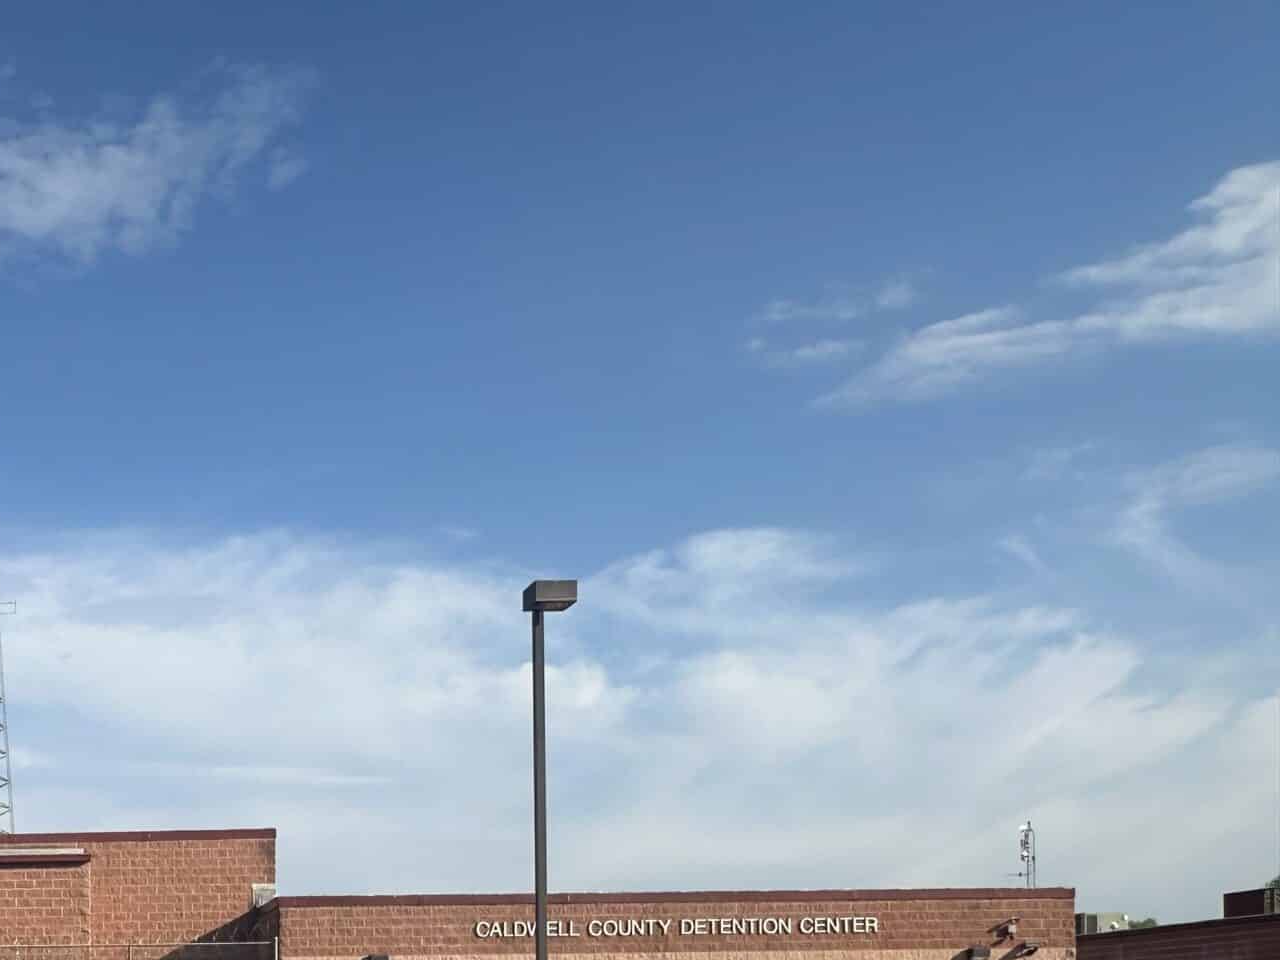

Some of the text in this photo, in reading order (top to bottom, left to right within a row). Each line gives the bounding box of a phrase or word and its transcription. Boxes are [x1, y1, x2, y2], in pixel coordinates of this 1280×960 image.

[588, 919, 671, 937] COUNTY
[681, 918, 792, 935] DETENTION
[799, 917, 878, 934] CENTER
